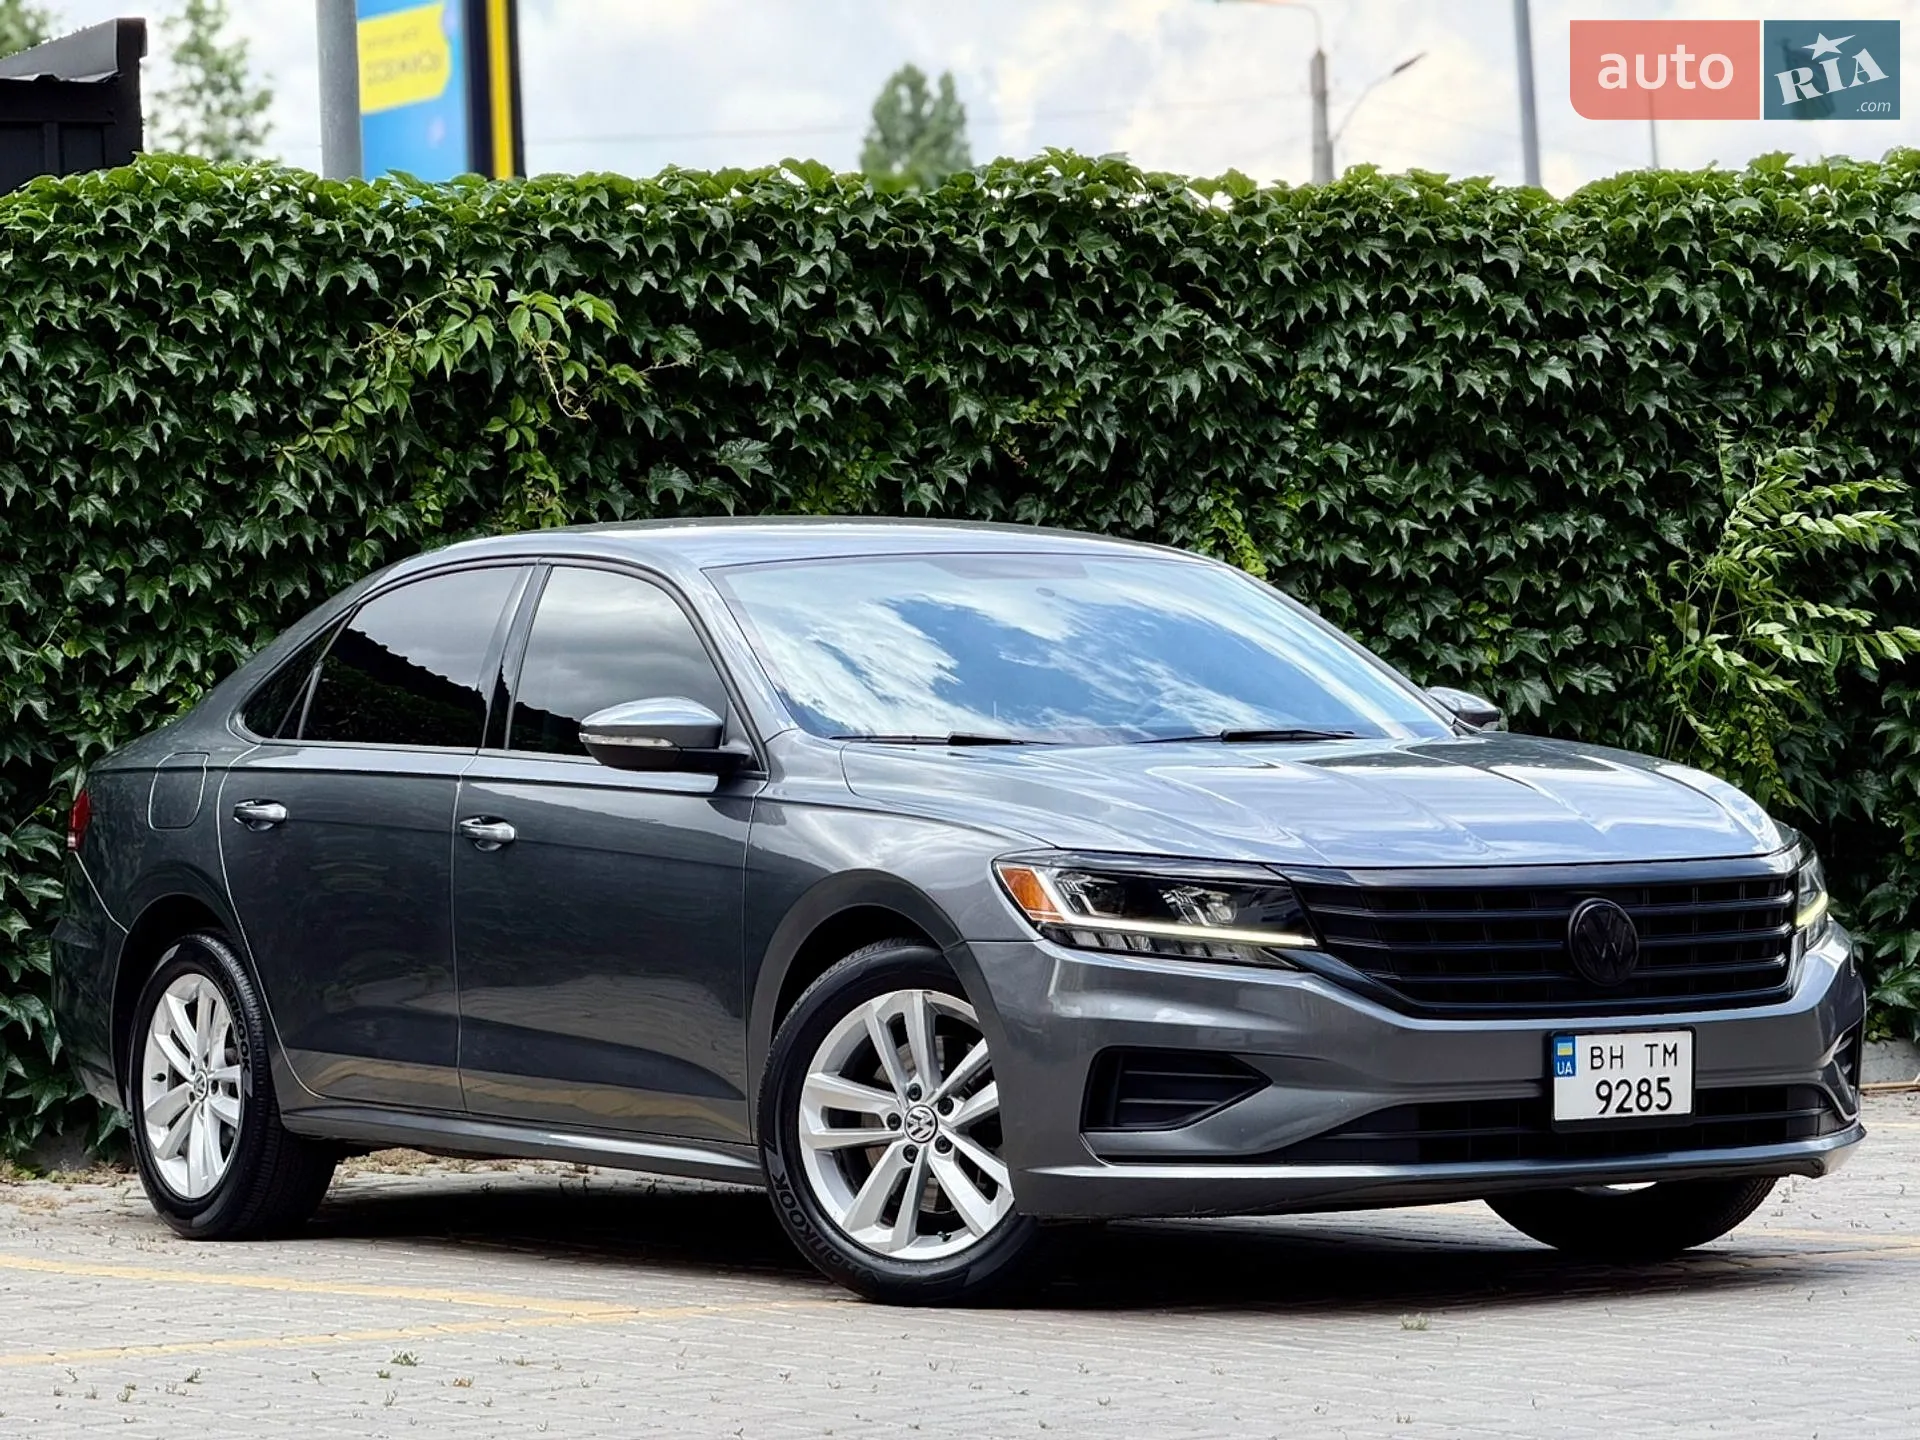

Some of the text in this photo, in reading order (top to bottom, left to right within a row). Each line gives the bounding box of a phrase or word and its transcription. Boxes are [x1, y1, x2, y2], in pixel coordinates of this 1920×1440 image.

[1556, 1061, 1573, 1076] UA
[1590, 1042, 1678, 1071] BH TM
[1595, 1076, 1673, 1115] 9285
